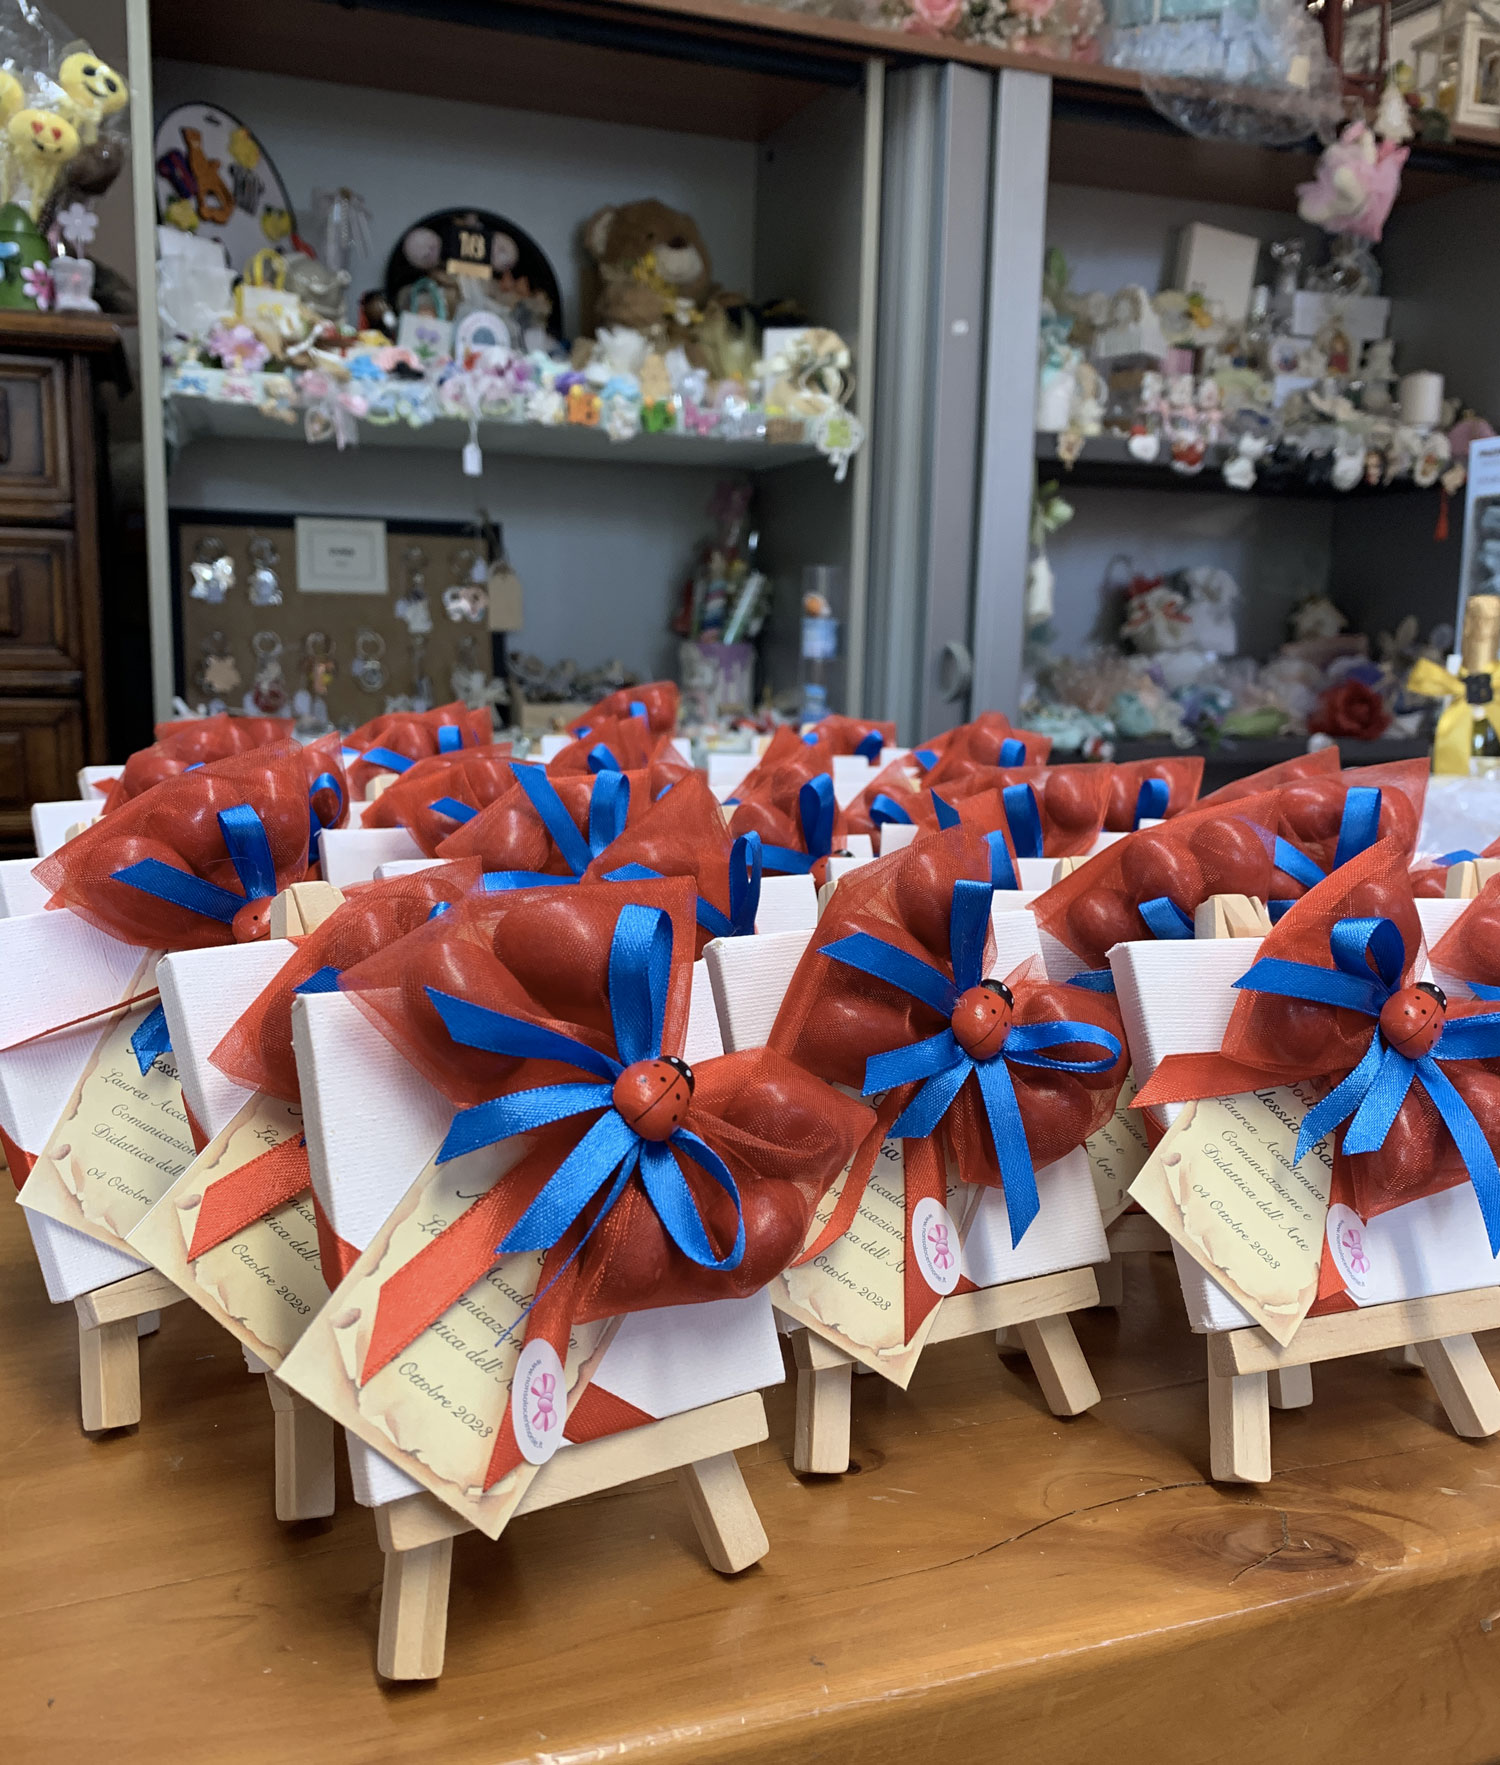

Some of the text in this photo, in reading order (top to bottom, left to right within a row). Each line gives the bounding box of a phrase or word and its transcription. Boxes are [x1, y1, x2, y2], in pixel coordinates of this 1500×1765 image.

[100, 1067, 151, 1101] Laurea
[111, 1103, 197, 1157] Comunicazion
[1253, 1090, 1301, 1135] lessia
[91, 1122, 156, 1164] Didattica
[1215, 1096, 1259, 1135] Laurea
[1258, 1138, 1327, 1202] Accademica
[87, 1167, 153, 1205] 04 Ottobre
[1201, 1142, 1310, 1252] Didattica dell' Arte
[1221, 1130, 1304, 1213] Comunicazione
[861, 1240, 890, 1261] dell'
[1192, 1184, 1281, 1270] 04 Ottobre 2023
[231, 1244, 311, 1315] Ottobre 2023
[813, 1255, 892, 1312] Ottobre 2023
[465, 1349, 503, 1374] dell'
[398, 1361, 452, 1409] Ottobre
[451, 1405, 493, 1439] 2023
